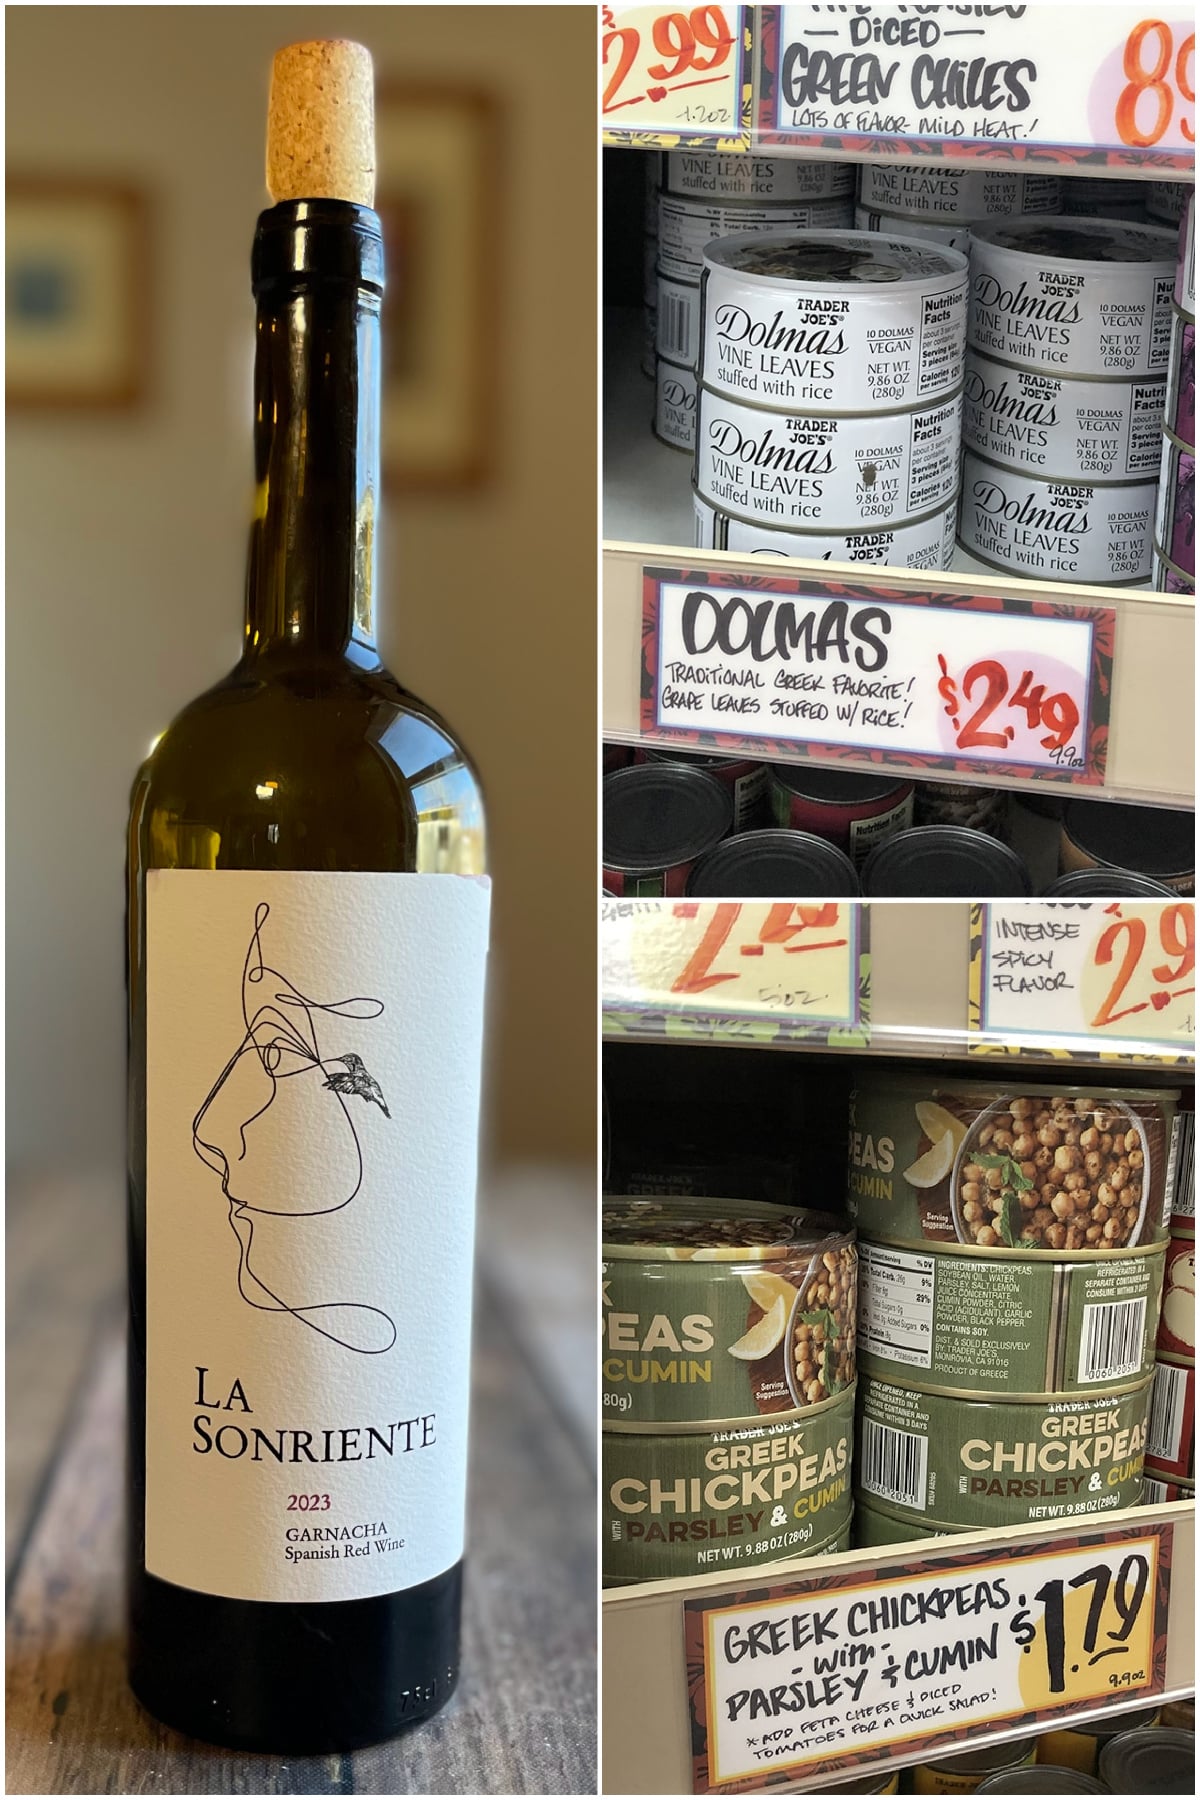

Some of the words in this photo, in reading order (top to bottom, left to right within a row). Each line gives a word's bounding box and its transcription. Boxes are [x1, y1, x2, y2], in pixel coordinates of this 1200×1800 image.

[781, 42, 901, 107] GREEN
[792, 109, 828, 128] LOTS
[833, 111, 853, 129] OF
[681, 158, 712, 175] VINE
[717, 162, 774, 178] LEAVES
[720, 180, 746, 192] with
[750, 181, 774, 193] rice
[872, 172, 898, 190] VINE
[903, 177, 959, 196] LEAVES
[904, 195, 929, 209] with
[934, 196, 958, 212] rice
[1038, 272, 1085, 288] TRADER
[797, 298, 850, 313] TRADER
[974, 273, 1084, 324] Dolmas
[1110, 304, 1146, 313] DOLMAS
[924, 310, 951, 325] Facts
[975, 307, 1001, 331] VINE
[1007, 318, 1070, 346] LEAVES
[1101, 315, 1143, 327] VEGAN
[715, 304, 850, 355] Dolmas
[866, 330, 877, 338] 10
[878, 327, 914, 338] DOLMAS
[869, 340, 912, 354] VEGAN
[1008, 341, 1036, 359] with
[1041, 348, 1069, 363] rice
[718, 342, 753, 369] VINE
[760, 354, 835, 379] LEAVES
[867, 363, 890, 375] NET
[717, 367, 758, 391] stuffed
[763, 380, 795, 397] with
[802, 385, 833, 400] rice
[867, 375, 891, 387] 9.86
[893, 372, 910, 384] OZ
[1018, 373, 1062, 391] TRADER
[872, 387, 905, 400] (280g)
[914, 407, 955, 429] Nutrition
[1085, 408, 1123, 418] DOLMAS
[785, 419, 838, 433] TRADER
[914, 426, 942, 442] Facts
[990, 416, 1048, 447] LEAVES
[1078, 420, 1121, 432] VEGAN
[709, 418, 838, 475] Dolmas
[855, 449, 864, 457] 10
[866, 444, 903, 457] DOLMAS
[991, 438, 1015, 457] with
[1020, 449, 1046, 465] rice
[711, 454, 744, 485] VINE
[751, 471, 824, 498] LEAVES
[711, 479, 748, 506] stuffed
[753, 497, 784, 515] with
[791, 502, 822, 518] rice
[856, 493, 879, 505] 9.86
[881, 490, 899, 502] OZ
[1047, 485, 1094, 498] TRADER
[860, 503, 894, 518] (280g)
[973, 480, 1093, 534] Dolmas
[1117, 510, 1149, 521] DOLMAS
[975, 511, 1007, 540] VINE
[1014, 527, 1080, 555] LEAVES
[1109, 521, 1147, 534] VEGAN
[845, 532, 894, 548] TRADER
[974, 532, 1011, 558] stuffed
[1015, 550, 1044, 567] with
[1050, 556, 1078, 572] rice
[681, 591, 892, 672] DOLMAS
[774, 669, 826, 692] GREEK
[662, 685, 704, 711] GRAPE
[711, 693, 761, 715] LEAVES
[770, 698, 829, 722] STUFFED
[937, 653, 1080, 750] $2.49
[996, 917, 1081, 942] INTENSE
[992, 971, 1075, 993] FLAVOR
[852, 1131, 895, 1173] EAS
[602, 1312, 714, 1353] EAS
[936, 1323, 971, 1335] CONTAINS
[603, 1358, 712, 1384] CUMIN
[934, 1363, 967, 1375] PRODUCT
[969, 1368, 978, 1376] OF
[980, 1369, 1009, 1379] GREECE
[194, 1366, 253, 1413] LA
[1041, 1408, 1121, 1438] GREEK
[193, 1413, 437, 1463] SONRIENTE
[960, 1418, 1147, 1473] CHICKPEAS
[704, 1433, 805, 1472] GREEK
[609, 1437, 848, 1514] CHICKPEAS
[958, 1475, 968, 1494] WITH
[970, 1475, 1086, 1499] PARSLEY
[1088, 1471, 1103, 1492] &
[287, 1494, 331, 1511] 2023
[626, 1511, 765, 1543] PARSLEY
[770, 1505, 788, 1527] &
[793, 1477, 847, 1519] CUMIN
[1029, 1505, 1046, 1519] NET
[1047, 1503, 1066, 1518] WT.
[286, 1521, 388, 1543] GARNACHA
[611, 1519, 622, 1542] WITH
[285, 1546, 340, 1564] Spanish
[343, 1541, 370, 1558] Red
[374, 1537, 405, 1553] Wine
[697, 1551, 721, 1564] NET
[721, 1547, 744, 1561] WT.
[746, 1541, 769, 1557] 9.88
[723, 1607, 839, 1665] GREEK
[847, 1578, 1012, 1638] CHICKPEAS
[1009, 1553, 1150, 1693] $1.79
[725, 1668, 869, 1722] PARSLEY
[904, 1622, 999, 1681] CUMIN
[800, 1715, 840, 1735] FETA
[846, 1700, 900, 1722] CHEESE
[920, 1683, 962, 1702] DICED
[752, 1730, 847, 1761] TOMATOES
[851, 1721, 879, 1736] FOR
[883, 1717, 895, 1729] A
[899, 1706, 944, 1724] QUICK
